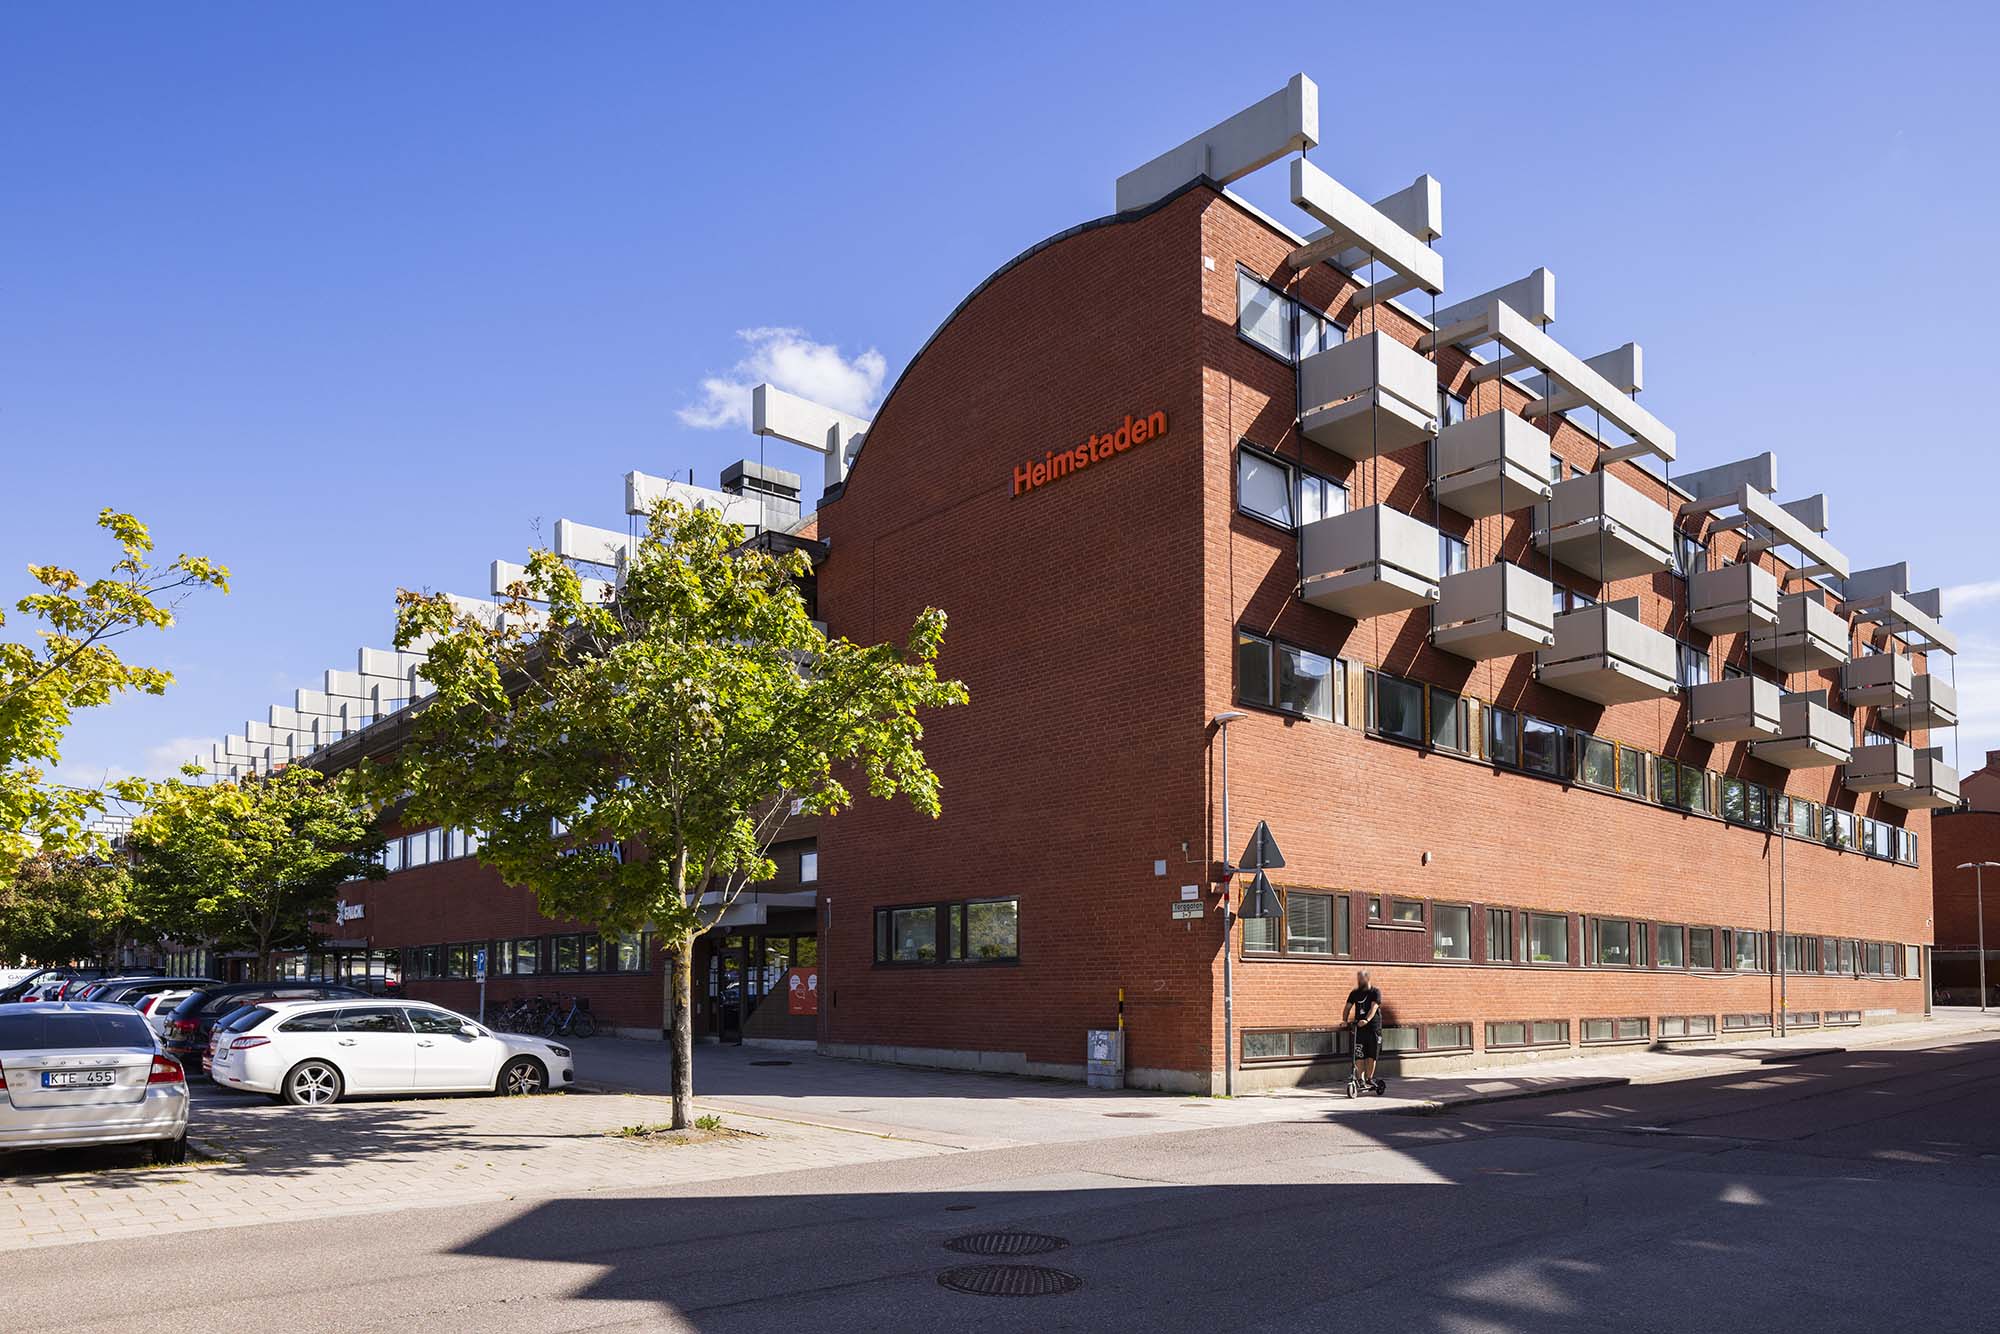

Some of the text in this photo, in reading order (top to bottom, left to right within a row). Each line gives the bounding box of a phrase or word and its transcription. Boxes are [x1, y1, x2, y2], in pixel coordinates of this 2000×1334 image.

[1012, 410, 1167, 496] Heimstaden
[51, 1071, 112, 1084] KTE 455
